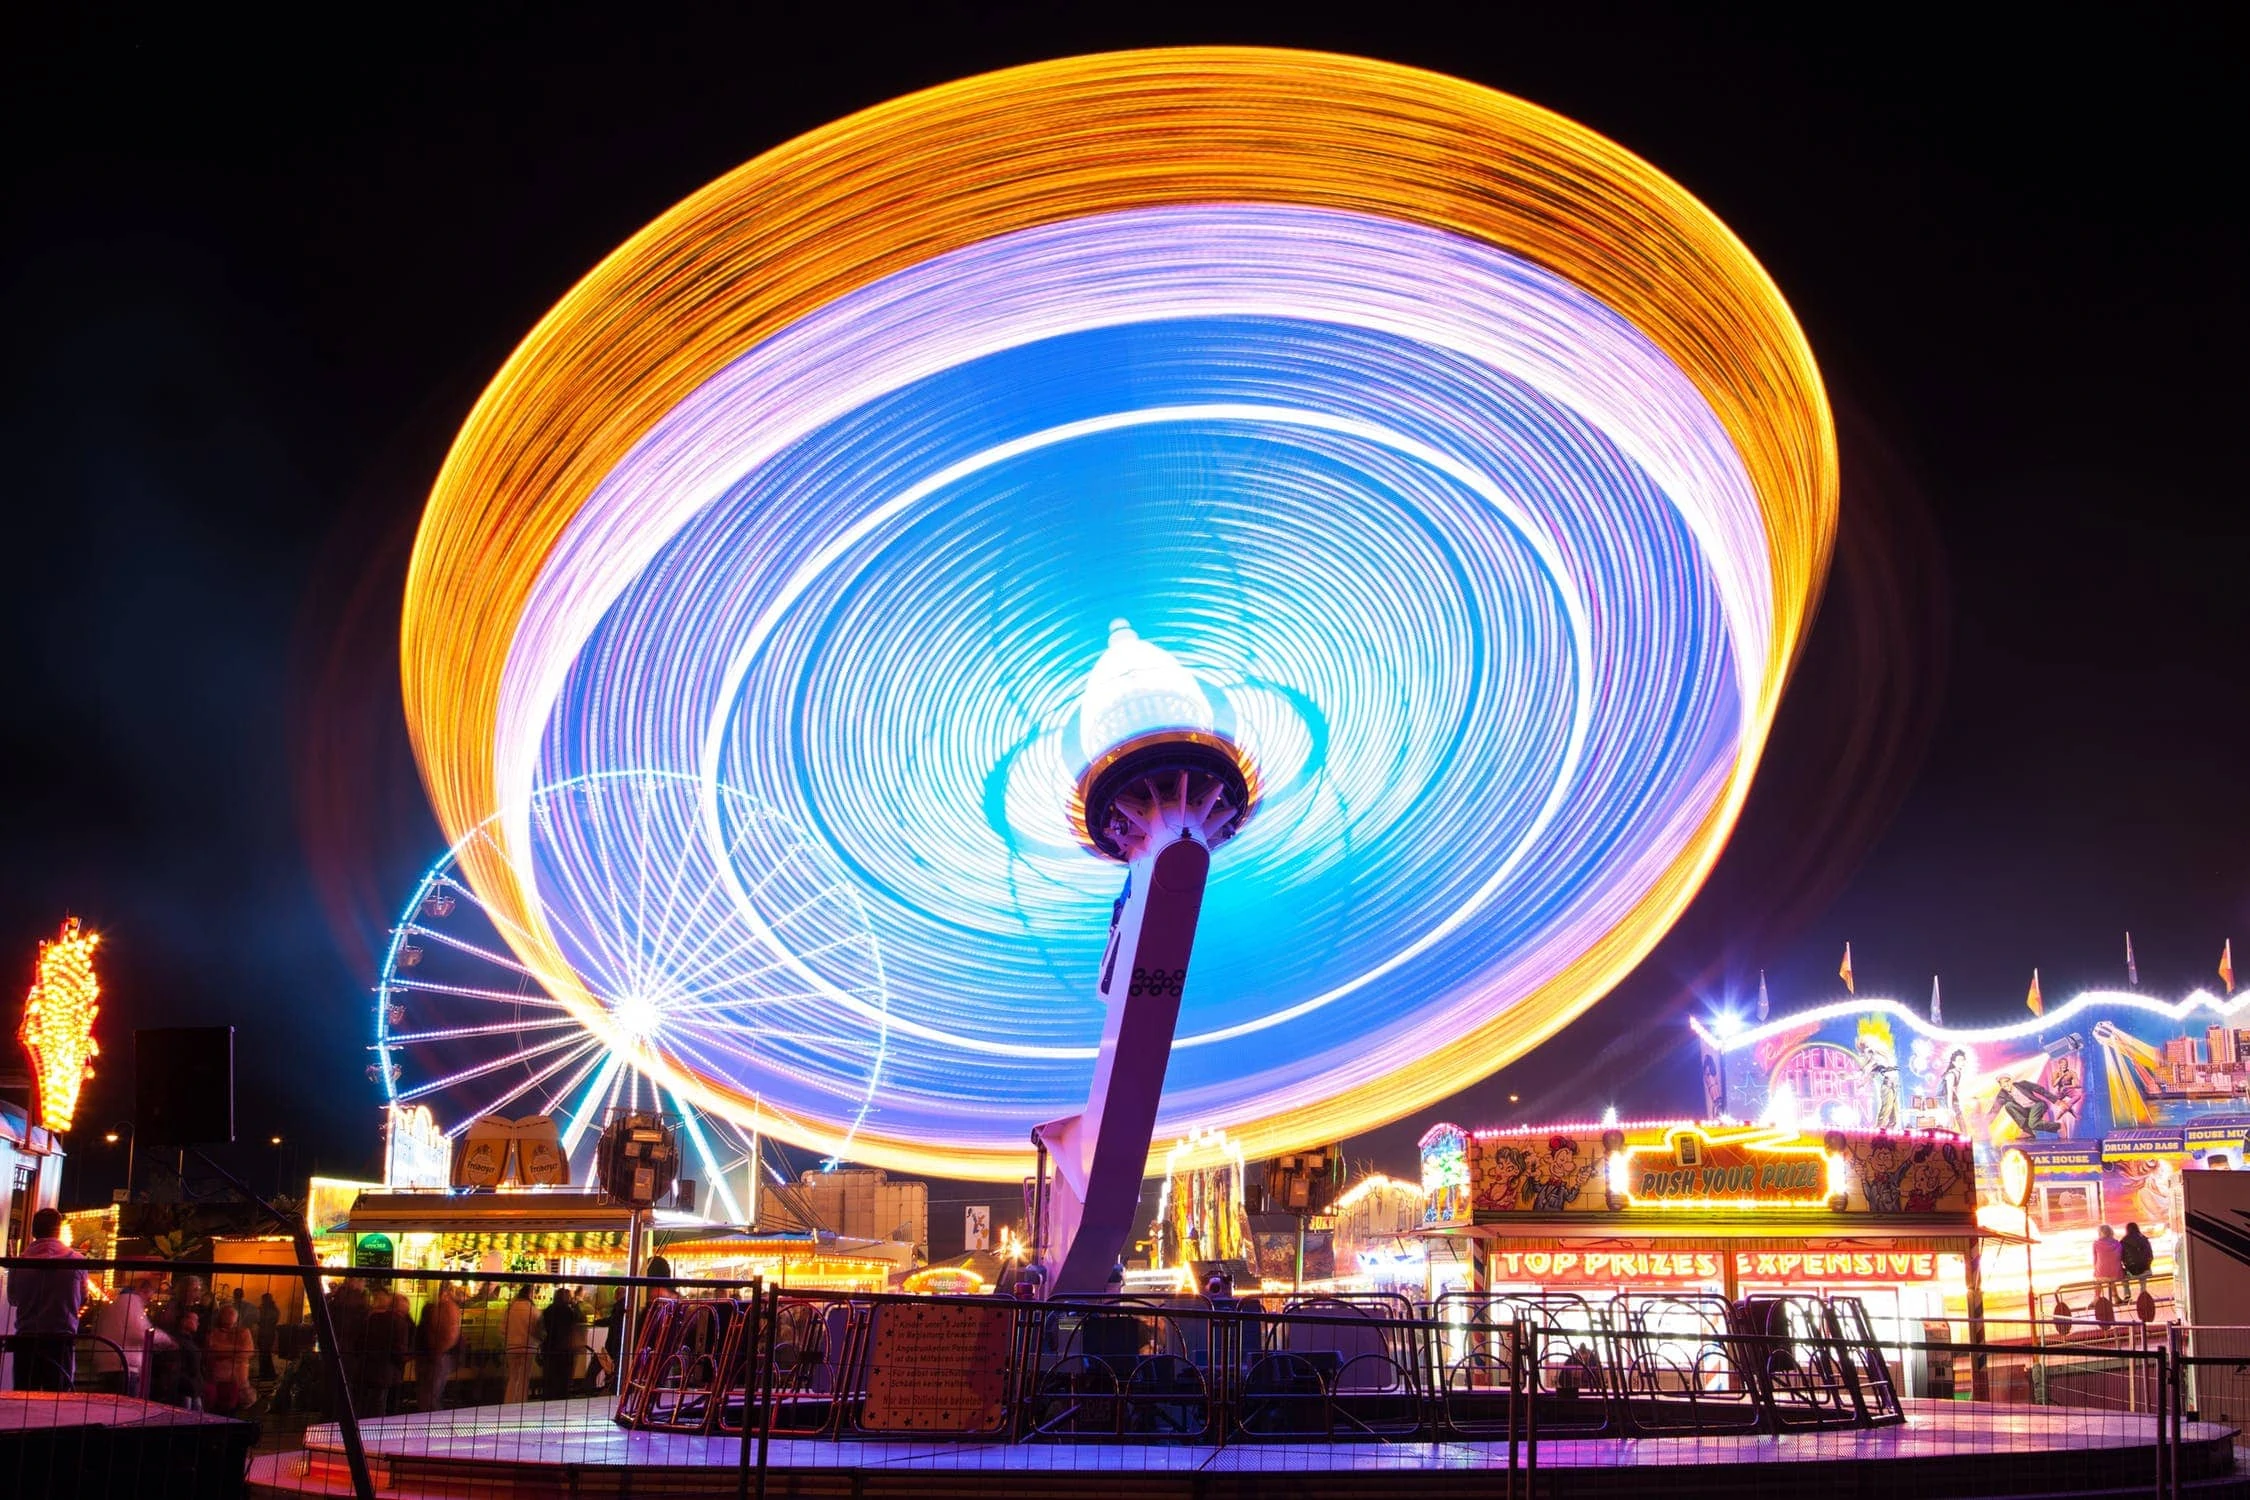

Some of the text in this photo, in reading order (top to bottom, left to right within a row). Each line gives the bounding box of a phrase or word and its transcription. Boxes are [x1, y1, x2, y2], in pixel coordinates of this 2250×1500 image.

[1791, 1048, 1855, 1069] THE NEW
[2188, 1129, 2249, 1140] HOUSE MU
[2104, 1141, 2179, 1152] DRUM AND BASS
[2052, 1155, 2090, 1164] HOUSE
[1640, 1160, 1819, 1198] PUSH YOUR PRIZE
[1501, 1252, 1718, 1277] TOP PRIZES
[1736, 1252, 1934, 1277] EXPENSIVE
